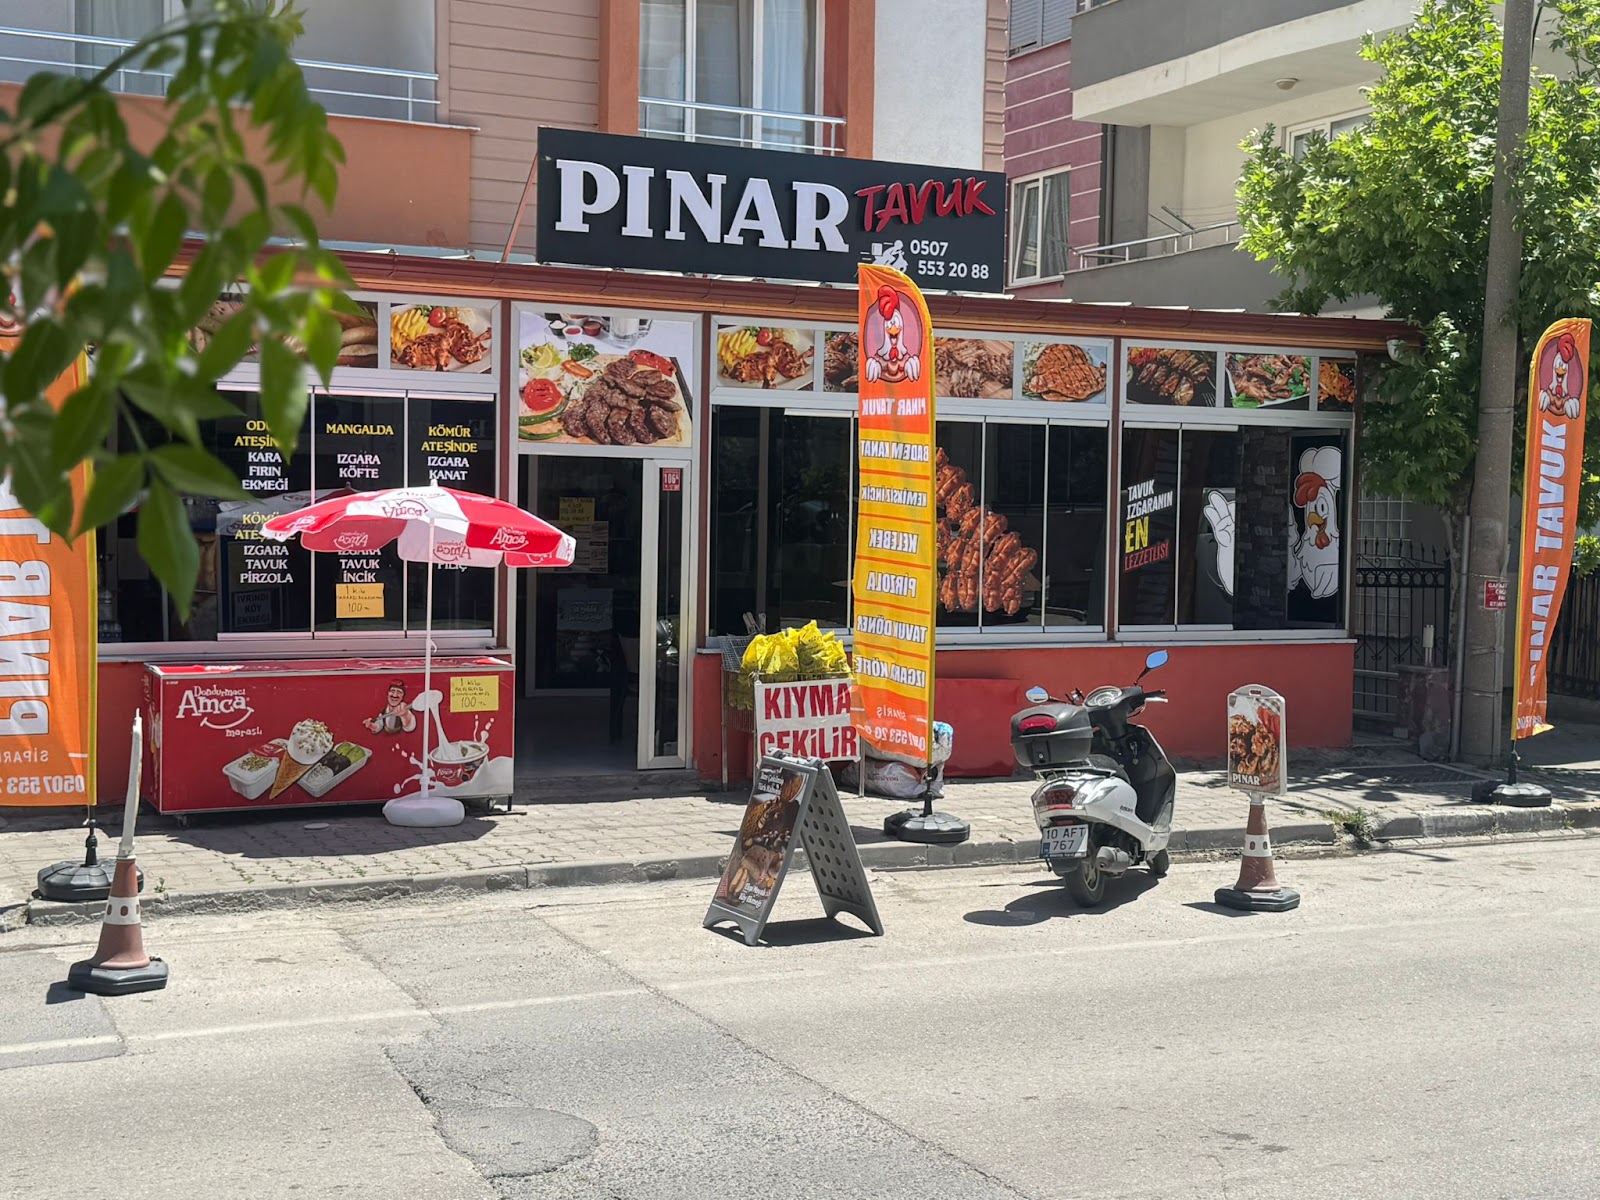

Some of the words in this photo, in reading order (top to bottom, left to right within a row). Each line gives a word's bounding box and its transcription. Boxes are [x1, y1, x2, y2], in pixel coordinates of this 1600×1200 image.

[554, 158, 850, 253] PINAR
[854, 176, 997, 233] TAVUK
[910, 239, 949, 257] 0507
[918, 260, 945, 276] 553
[948, 262, 968, 278] 20
[971, 264, 989, 279] 88
[246, 420, 271, 432] OD
[326, 423, 394, 435] MANGALDA
[428, 424, 471, 438] KÖMÜR
[421, 440, 478, 454] ATEŞİNDE
[248, 452, 282, 463] KARA
[337, 454, 381, 465] IZGARA
[427, 456, 470, 467] IZGARA
[249, 466, 281, 476] FIRIN
[339, 465, 379, 478] KÖFTE
[429, 470, 468, 480] KANAT
[242, 478, 289, 491] EKMEĞİ
[1127, 479, 1155, 502] TAVUK
[1534, 419, 1567, 553] TAVUK
[1126, 490, 1173, 521] IZGARANIN
[489, 528, 526, 544] Amca
[1125, 516, 1149, 554] EN
[244, 545, 290, 556] IZGARA
[245, 559, 288, 570] TAVUK
[339, 559, 380, 569] TAVUK
[240, 571, 294, 583] PİRZOLA
[343, 570, 376, 582] İNCİK
[175, 689, 247, 718] Amca
[764, 683, 851, 720] KIYMA
[1232, 773, 1260, 785] PINAR
[1046, 828, 1058, 839] 10
[1063, 827, 1085, 838] AFT
[1052, 840, 1075, 851] 767
